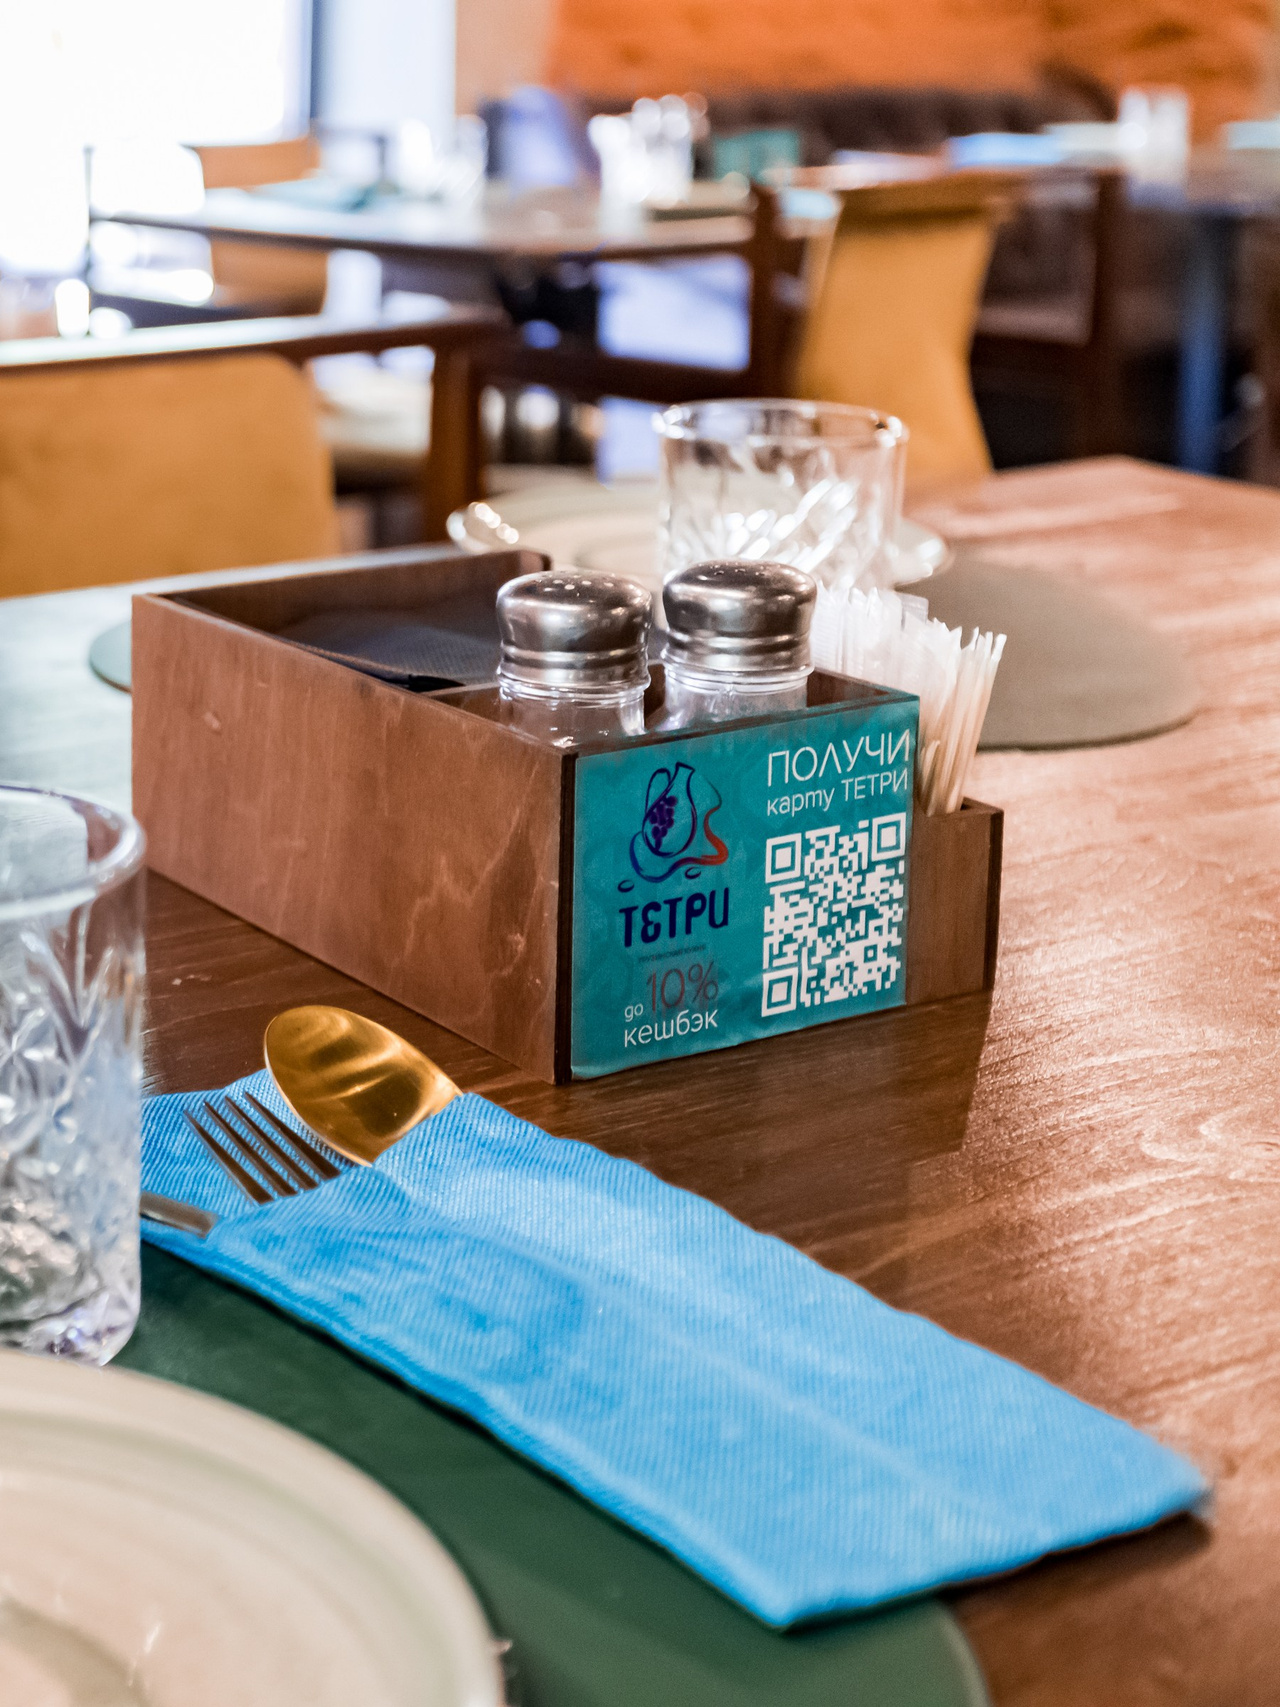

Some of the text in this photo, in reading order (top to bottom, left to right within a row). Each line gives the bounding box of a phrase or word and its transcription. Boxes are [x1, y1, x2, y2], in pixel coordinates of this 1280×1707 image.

[767, 728, 910, 787] ПОЛУЧИ
[767, 767, 908, 818] карту ТЕТРИ
[624, 960, 719, 1022] до 10%
[624, 1009, 718, 1048] кешбэк
